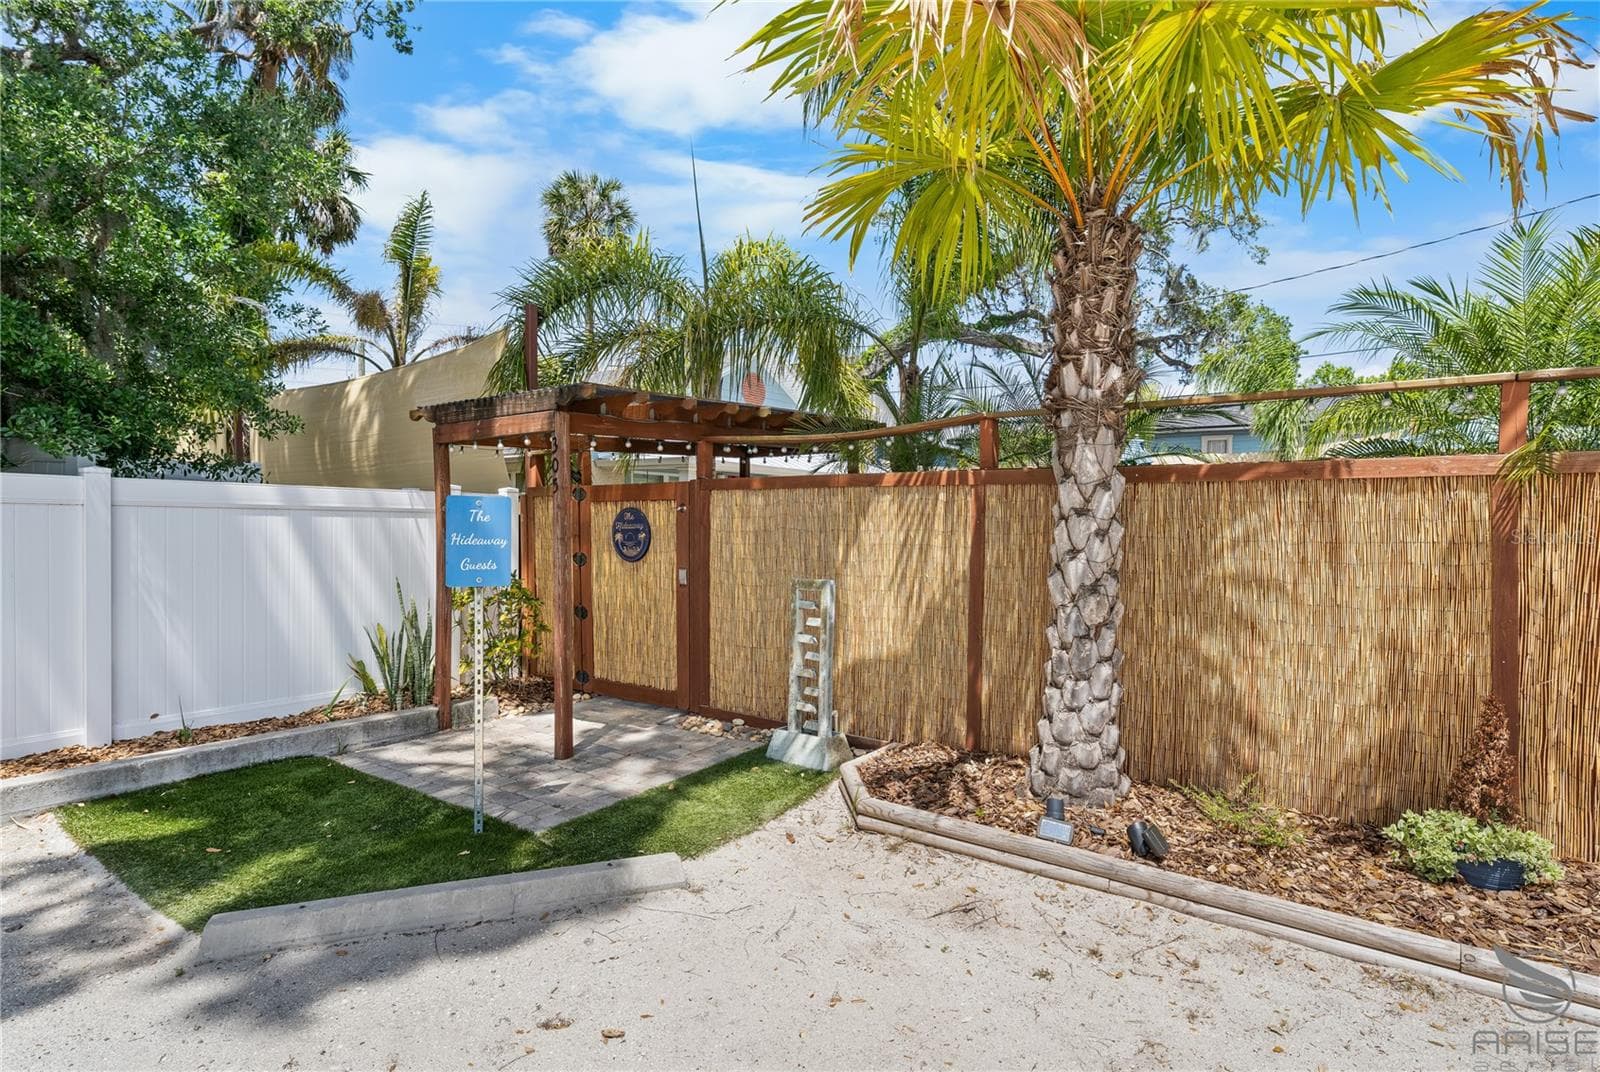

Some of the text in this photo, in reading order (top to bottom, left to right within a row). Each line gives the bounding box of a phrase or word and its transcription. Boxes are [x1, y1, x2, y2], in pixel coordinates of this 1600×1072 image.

[469, 509, 491, 522] The
[450, 532, 507, 549] Hideaway
[460, 557, 497, 571] Guests
